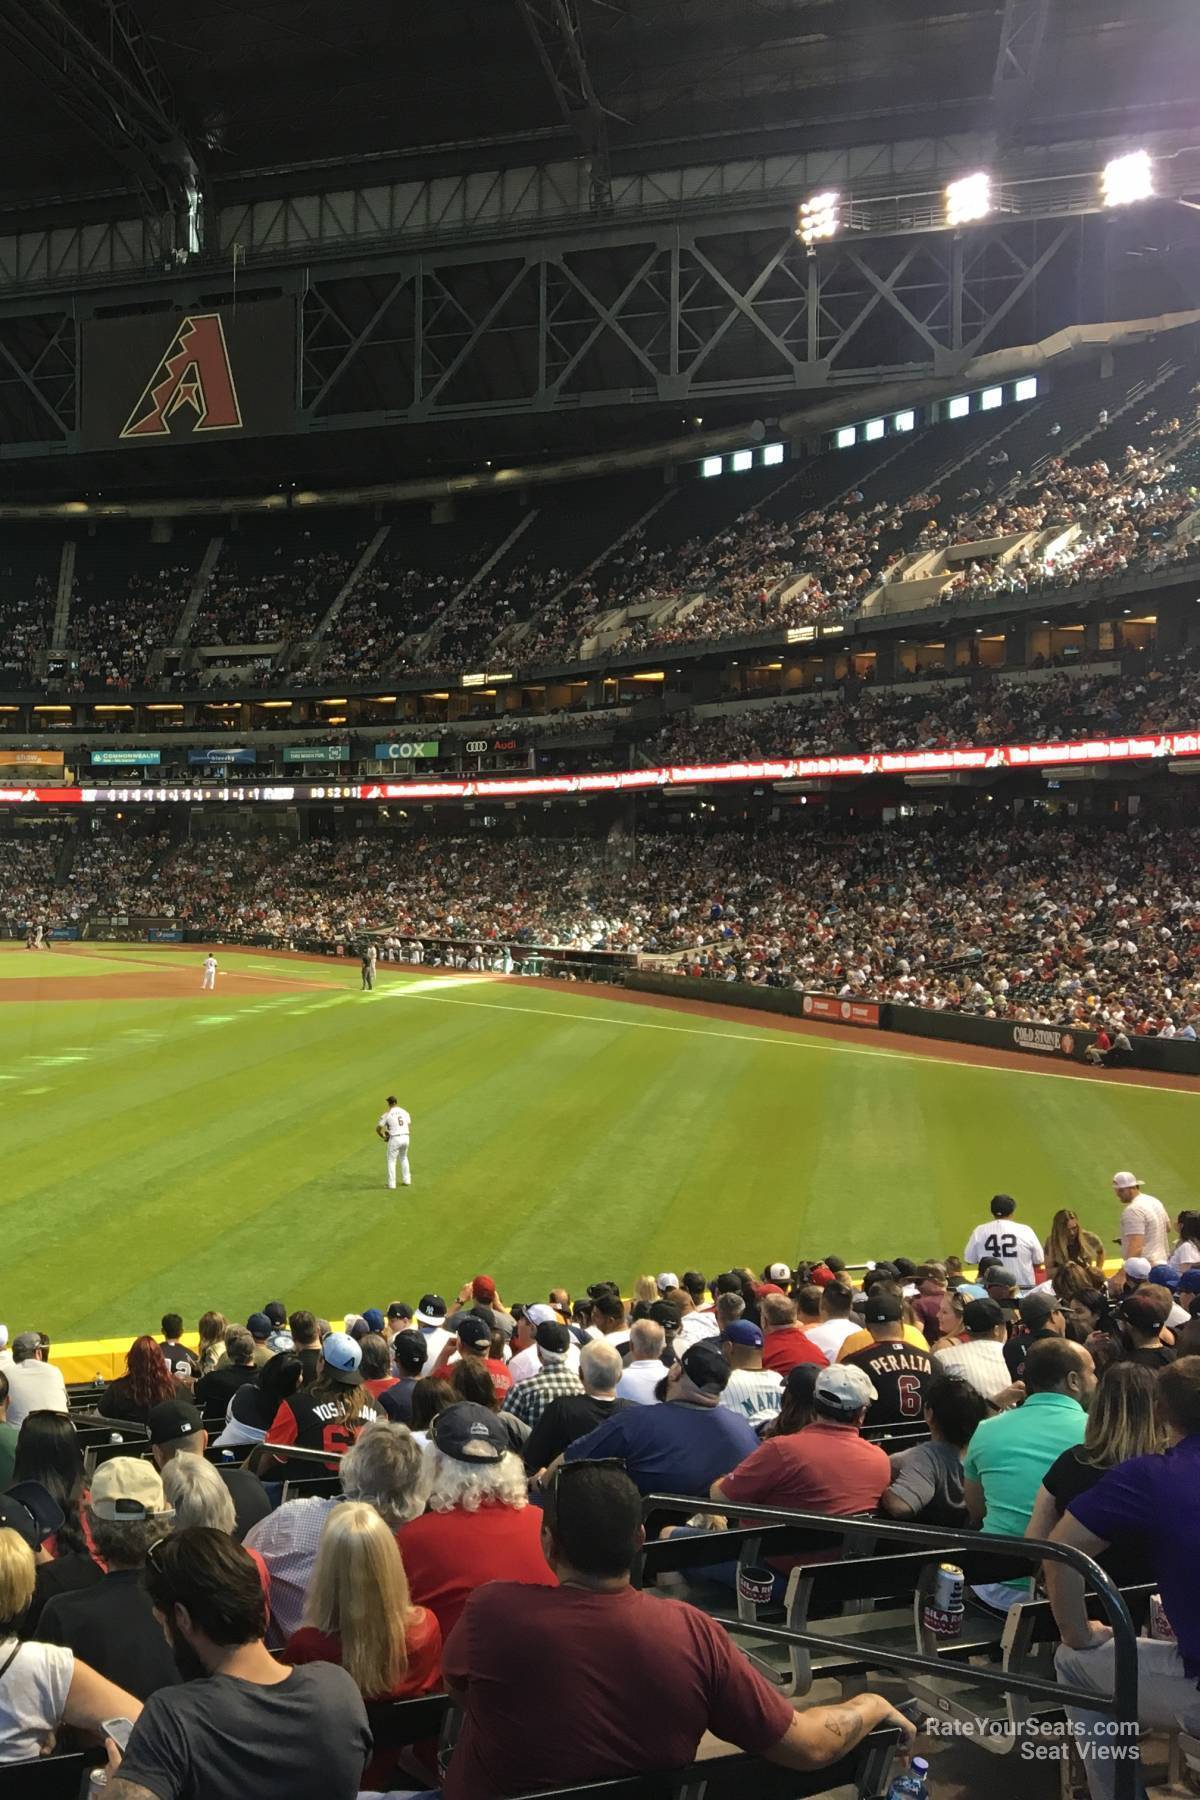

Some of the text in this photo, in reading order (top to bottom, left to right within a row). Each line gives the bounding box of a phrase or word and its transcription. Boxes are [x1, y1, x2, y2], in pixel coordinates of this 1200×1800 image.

[389, 743, 425, 758] COX
[494, 740, 516, 750] Audi
[1013, 1026, 1034, 1044] COLD
[1034, 1029, 1061, 1049] STONE
[984, 1234, 1017, 1257] 42
[869, 1353, 931, 1376] PERALTA
[897, 1374, 922, 1417] 6
